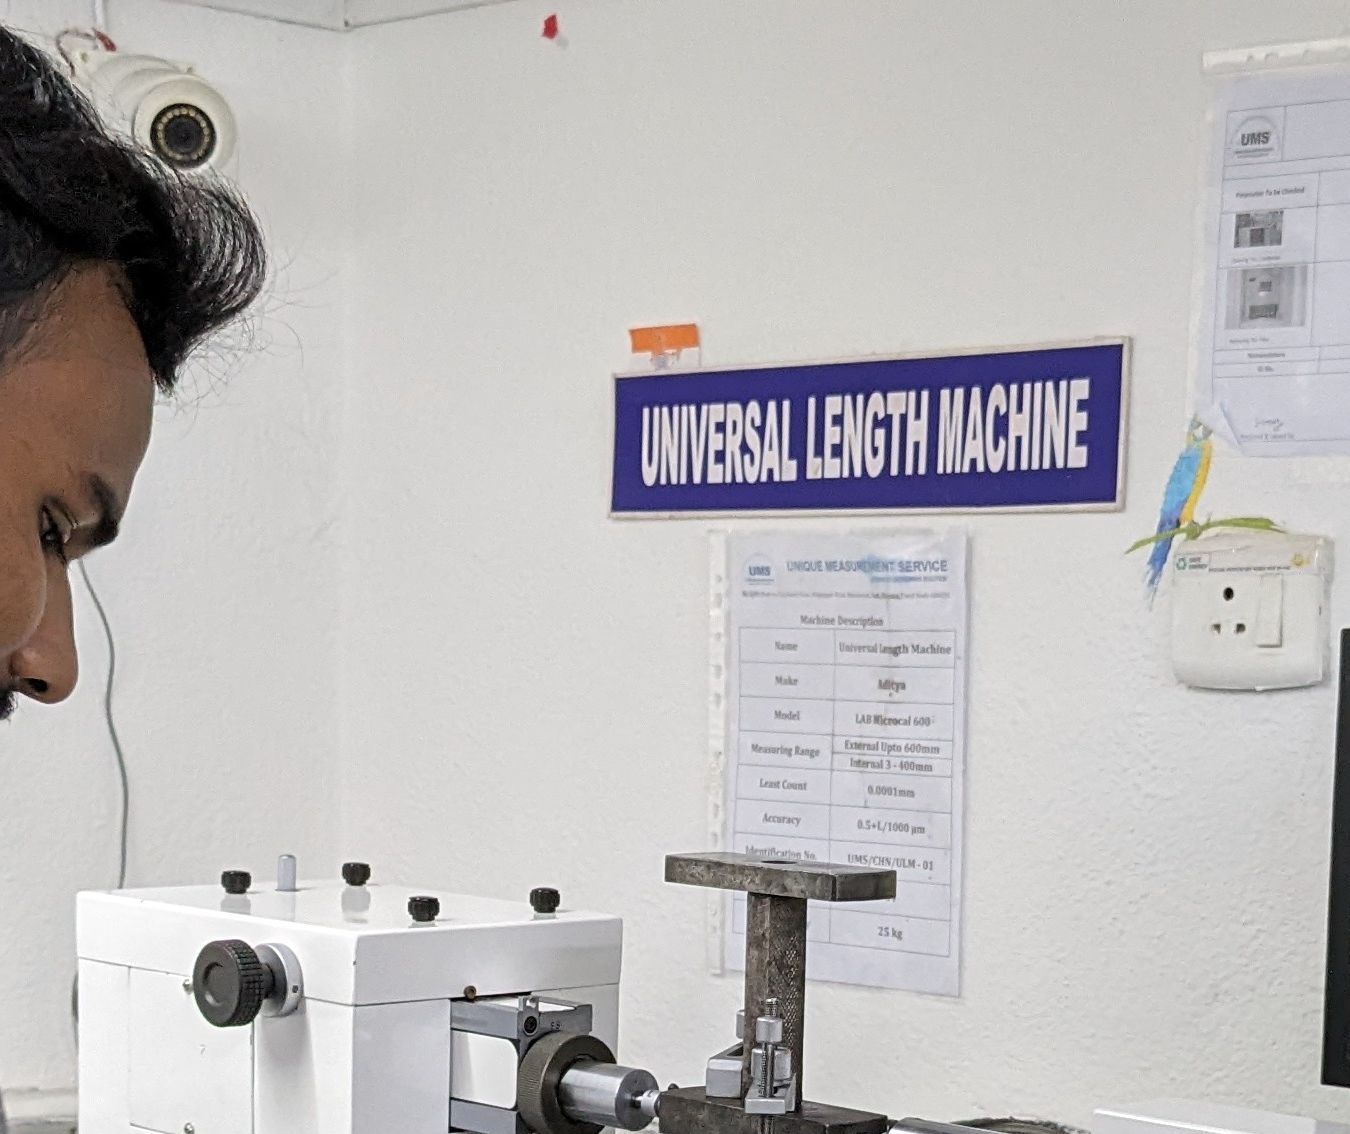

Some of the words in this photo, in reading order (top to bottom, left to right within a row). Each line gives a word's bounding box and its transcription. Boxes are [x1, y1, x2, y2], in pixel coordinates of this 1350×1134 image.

[1240, 131, 1271, 147] UMS
[641, 394, 798, 487] UNIVERSAL
[806, 389, 929, 480] LENGTH
[937, 378, 1089, 474] MACHINE
[748, 565, 771, 576] UMS
[787, 560, 823, 572] UNIQUE
[899, 560, 948, 572] SERVICE
[800, 615, 835, 626] Machine
[838, 616, 884, 628] Description
[775, 641, 798, 651] Name
[839, 642, 878, 654] Universal
[911, 643, 952, 655] Machine
[775, 675, 799, 686] Make
[878, 679, 906, 691] Aditya
[774, 710, 801, 720] Model
[855, 714, 872, 725] LAB
[913, 716, 931, 727] 600
[751, 743, 793, 757] Measuring
[795, 746, 820, 759] Range
[844, 740, 879, 752] External
[881, 742, 902, 755] Upto
[904, 743, 941, 755] 600mm
[850, 757, 884, 770] Internal
[885, 759, 891, 770] 3
[759, 777, 780, 790] Least
[781, 779, 807, 791] Count
[867, 785, 916, 798] 0.0001mm
[762, 813, 801, 826] Accuracy
[803, 850, 817, 860] No.
[923, 860, 934, 871] 01
[877, 927, 891, 937] 25
[892, 927, 903, 940] kg
